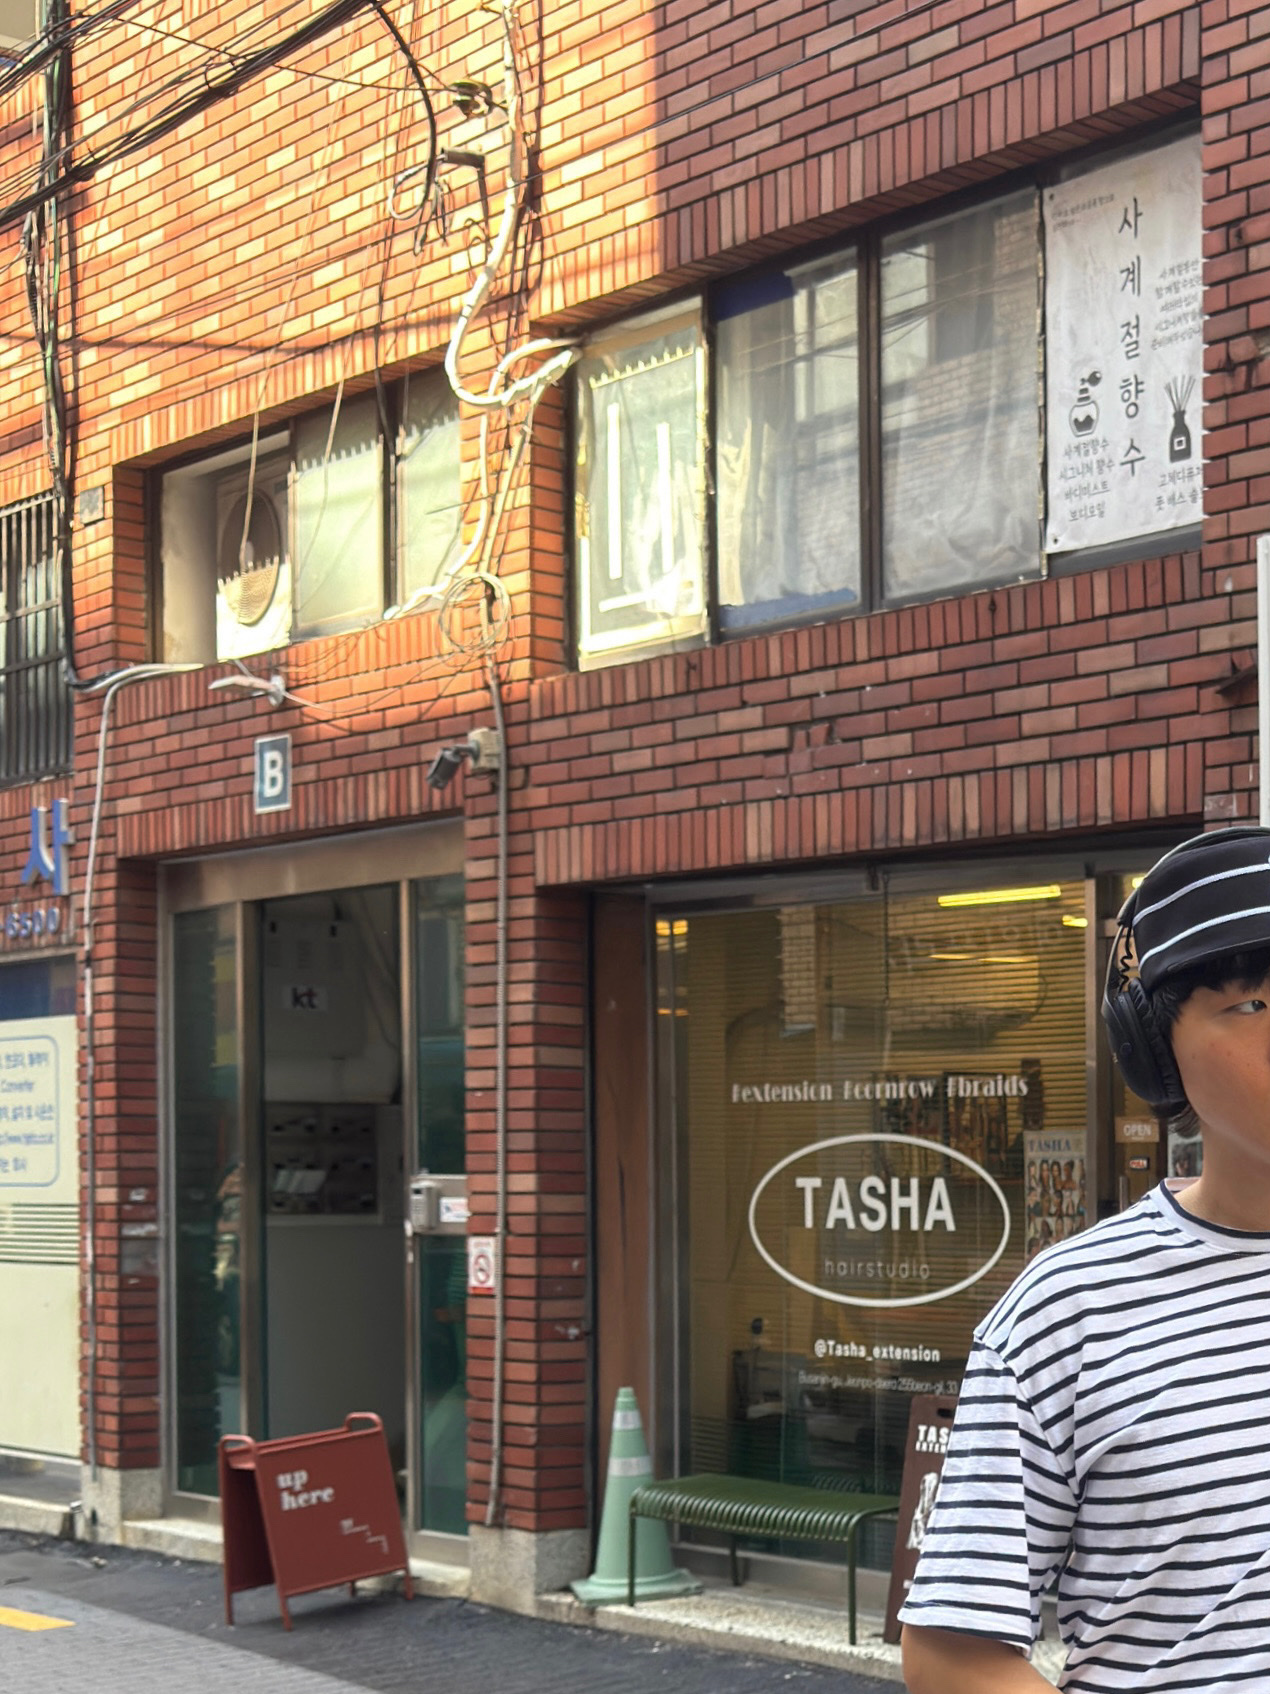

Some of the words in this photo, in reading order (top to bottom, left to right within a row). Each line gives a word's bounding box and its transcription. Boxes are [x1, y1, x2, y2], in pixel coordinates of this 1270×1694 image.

[1118, 197, 1146, 477] 사계절향수
[263, 751, 284, 797] B
[20, 798, 76, 895] 사
[291, 986, 317, 1010] kt
[731, 1080, 832, 1103] #extension
[843, 1078, 936, 1101] #cornrow
[946, 1074, 1029, 1098] #braids
[1123, 1124, 1152, 1137] OPEN
[1029, 1139, 1071, 1152] TASHA
[795, 1175, 956, 1232] TASHA
[824, 1258, 930, 1280] hairstudio
[814, 1339, 941, 1362] @Tasha_extension
[917, 1424, 950, 1444] TAS
[915, 1441, 946, 1454] EXTEN
[277, 1469, 308, 1491] up
[281, 1487, 334, 1511] here
